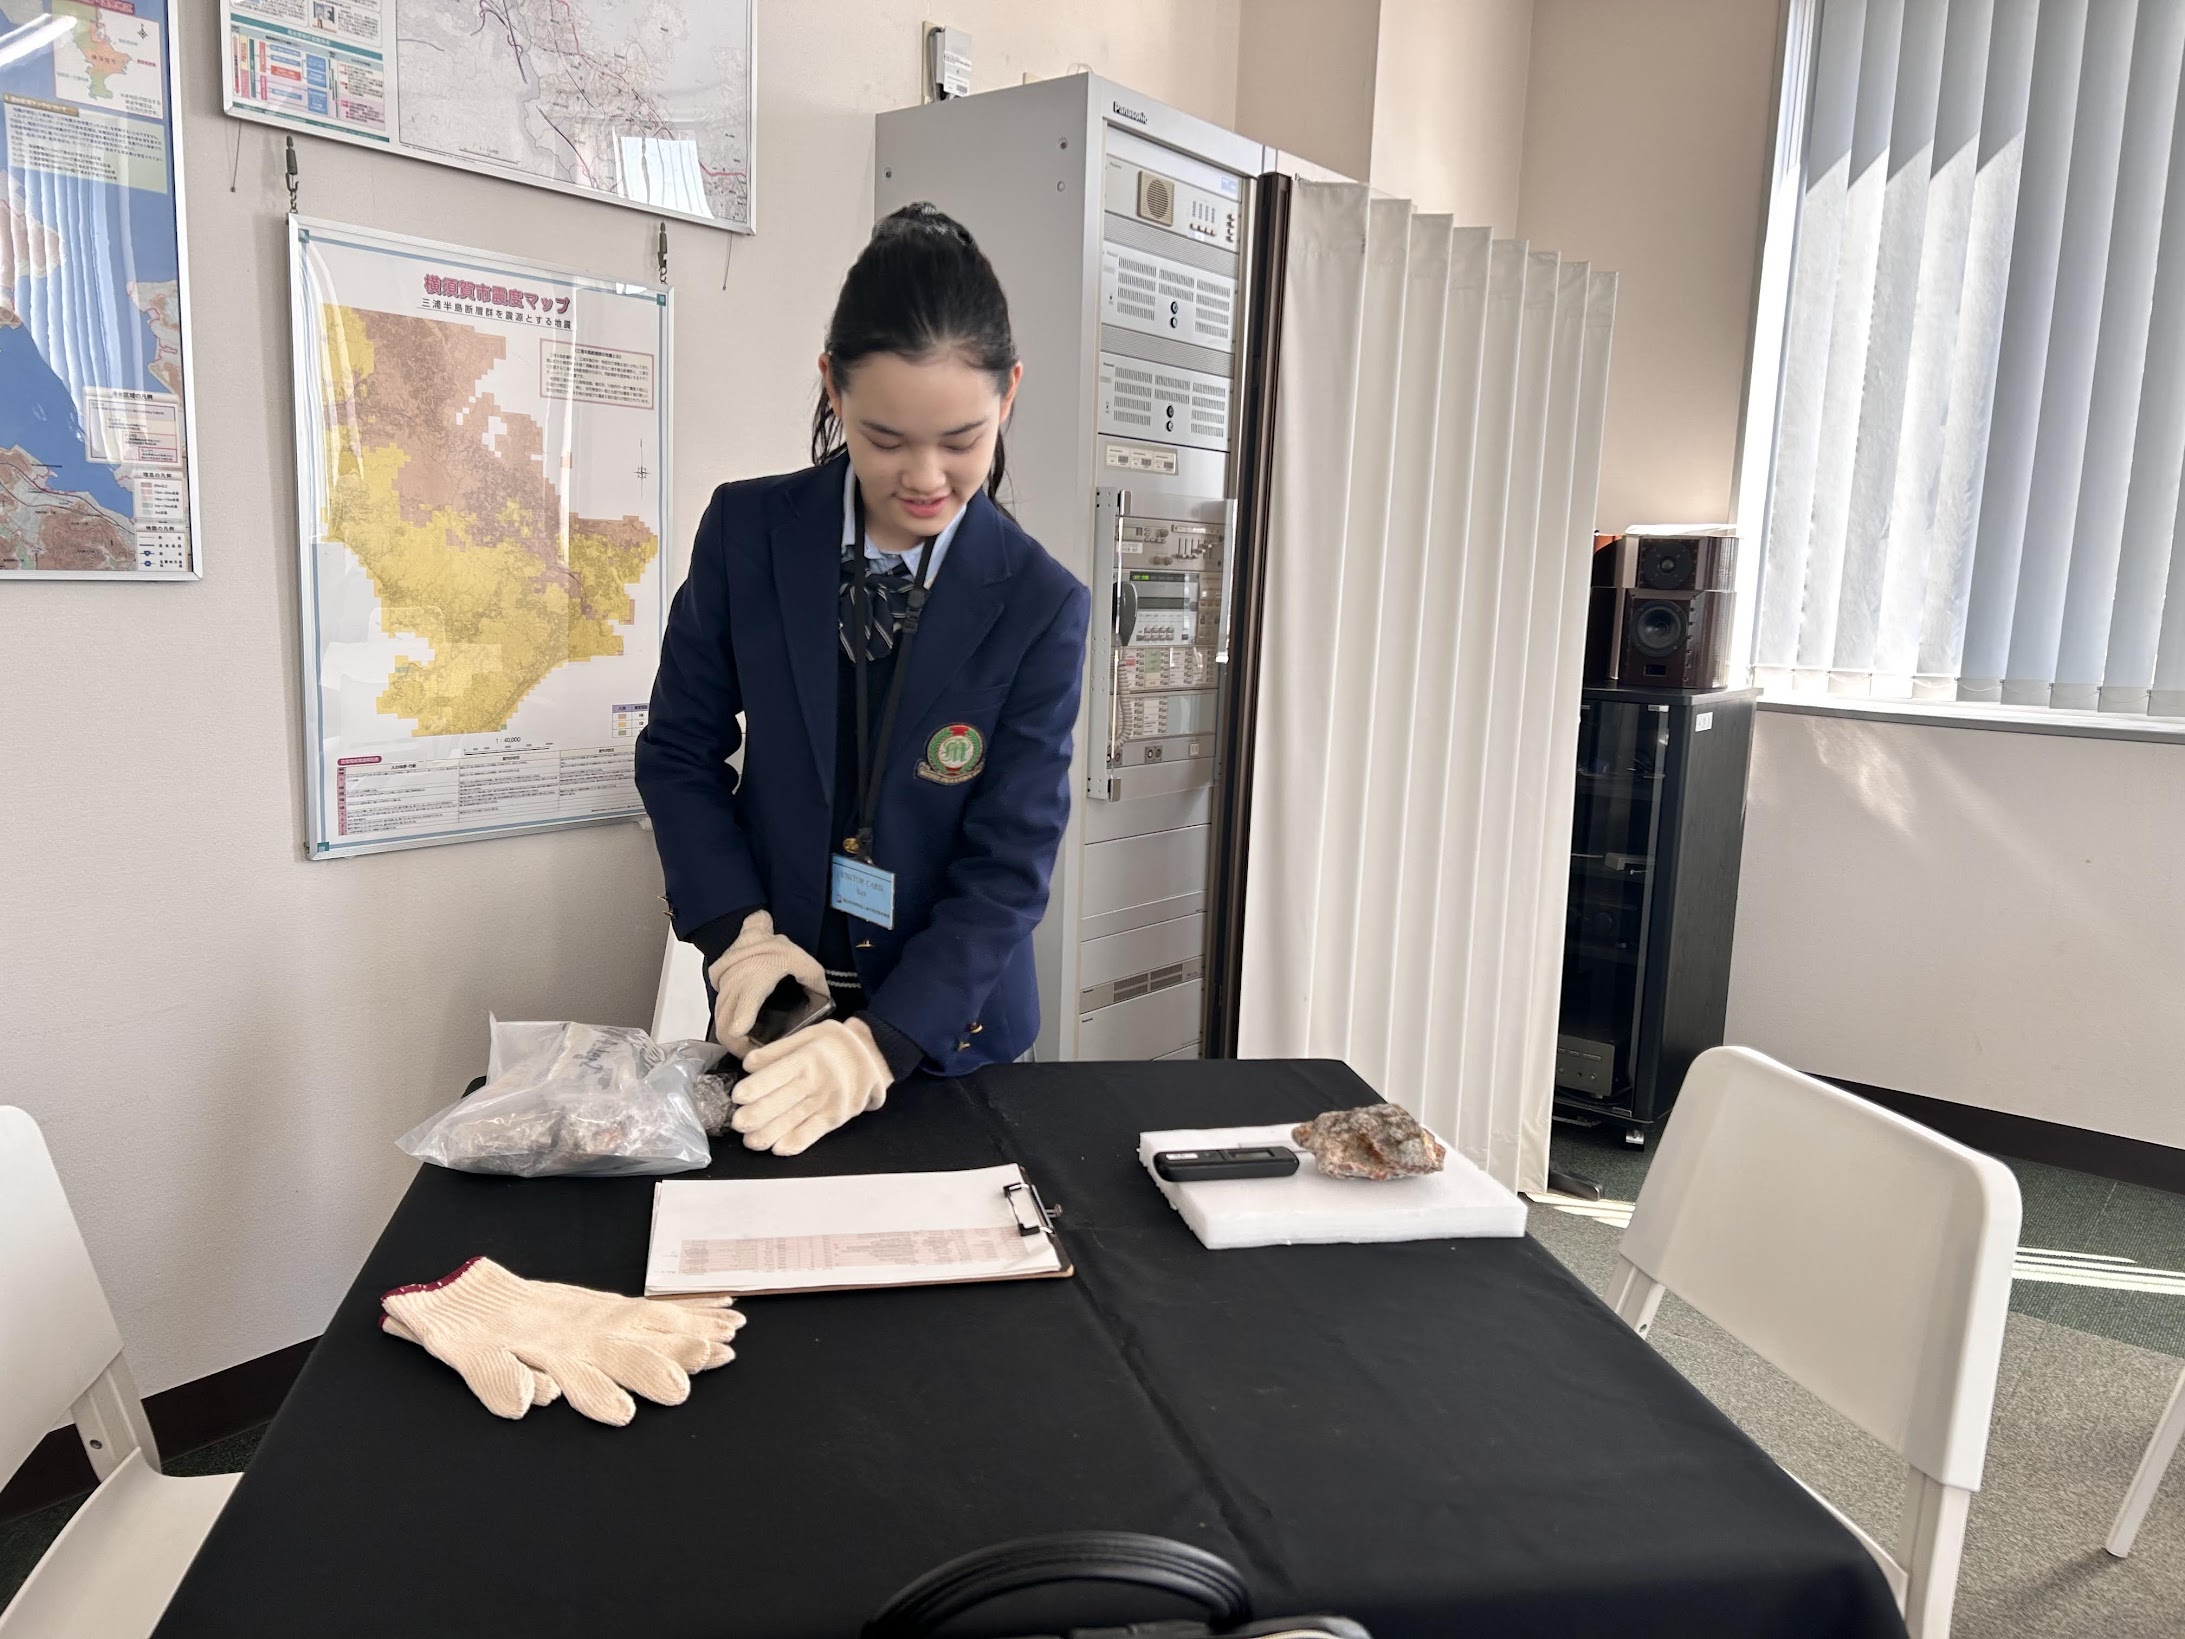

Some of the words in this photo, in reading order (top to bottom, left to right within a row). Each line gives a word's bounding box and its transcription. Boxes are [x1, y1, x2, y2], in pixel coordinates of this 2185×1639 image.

[1113, 101, 1149, 125] Panasonic
[424, 273, 571, 315] 横須賀市震度マップ
[421, 298, 572, 330] 三浦半島断層群を震源とする地震
[840, 871, 865, 885] VISITOR
[866, 880, 883, 892] CARD
